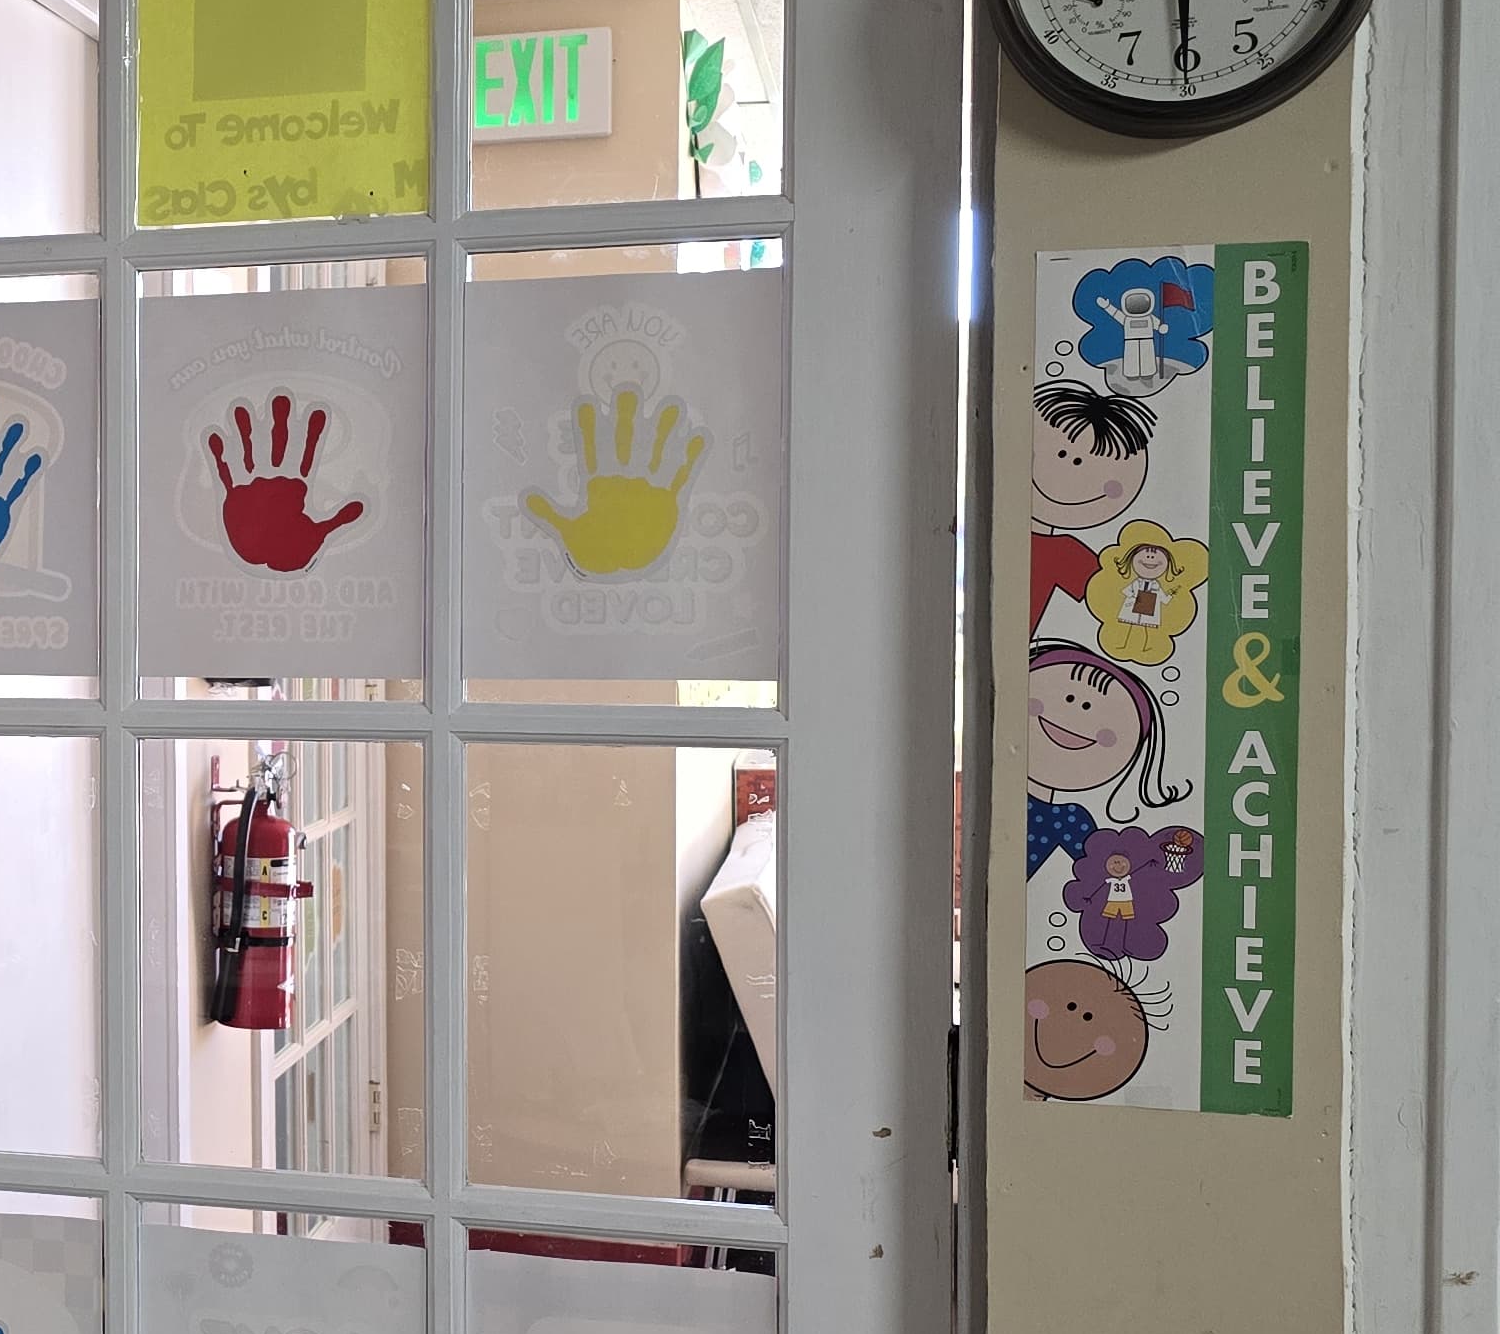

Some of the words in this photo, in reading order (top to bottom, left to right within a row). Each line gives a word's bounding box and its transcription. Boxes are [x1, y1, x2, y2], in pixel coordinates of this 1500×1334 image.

[1043, 29, 1060, 45] 40
[1117, 30, 1143, 67] 7
[1173, 35, 1201, 72] 6
[1232, 17, 1259, 54] 5
[1256, 53, 1275, 70] 25
[474, 33, 588, 128] EXIT
[1100, 74, 1119, 89] 35
[1179, 83, 1197, 98] 30
[1231, 260, 1283, 621] BELIEVE
[1221, 631, 1285, 709] &
[1114, 883, 1126, 892] 33
[1224, 730, 1278, 1085] ACHIEVE
